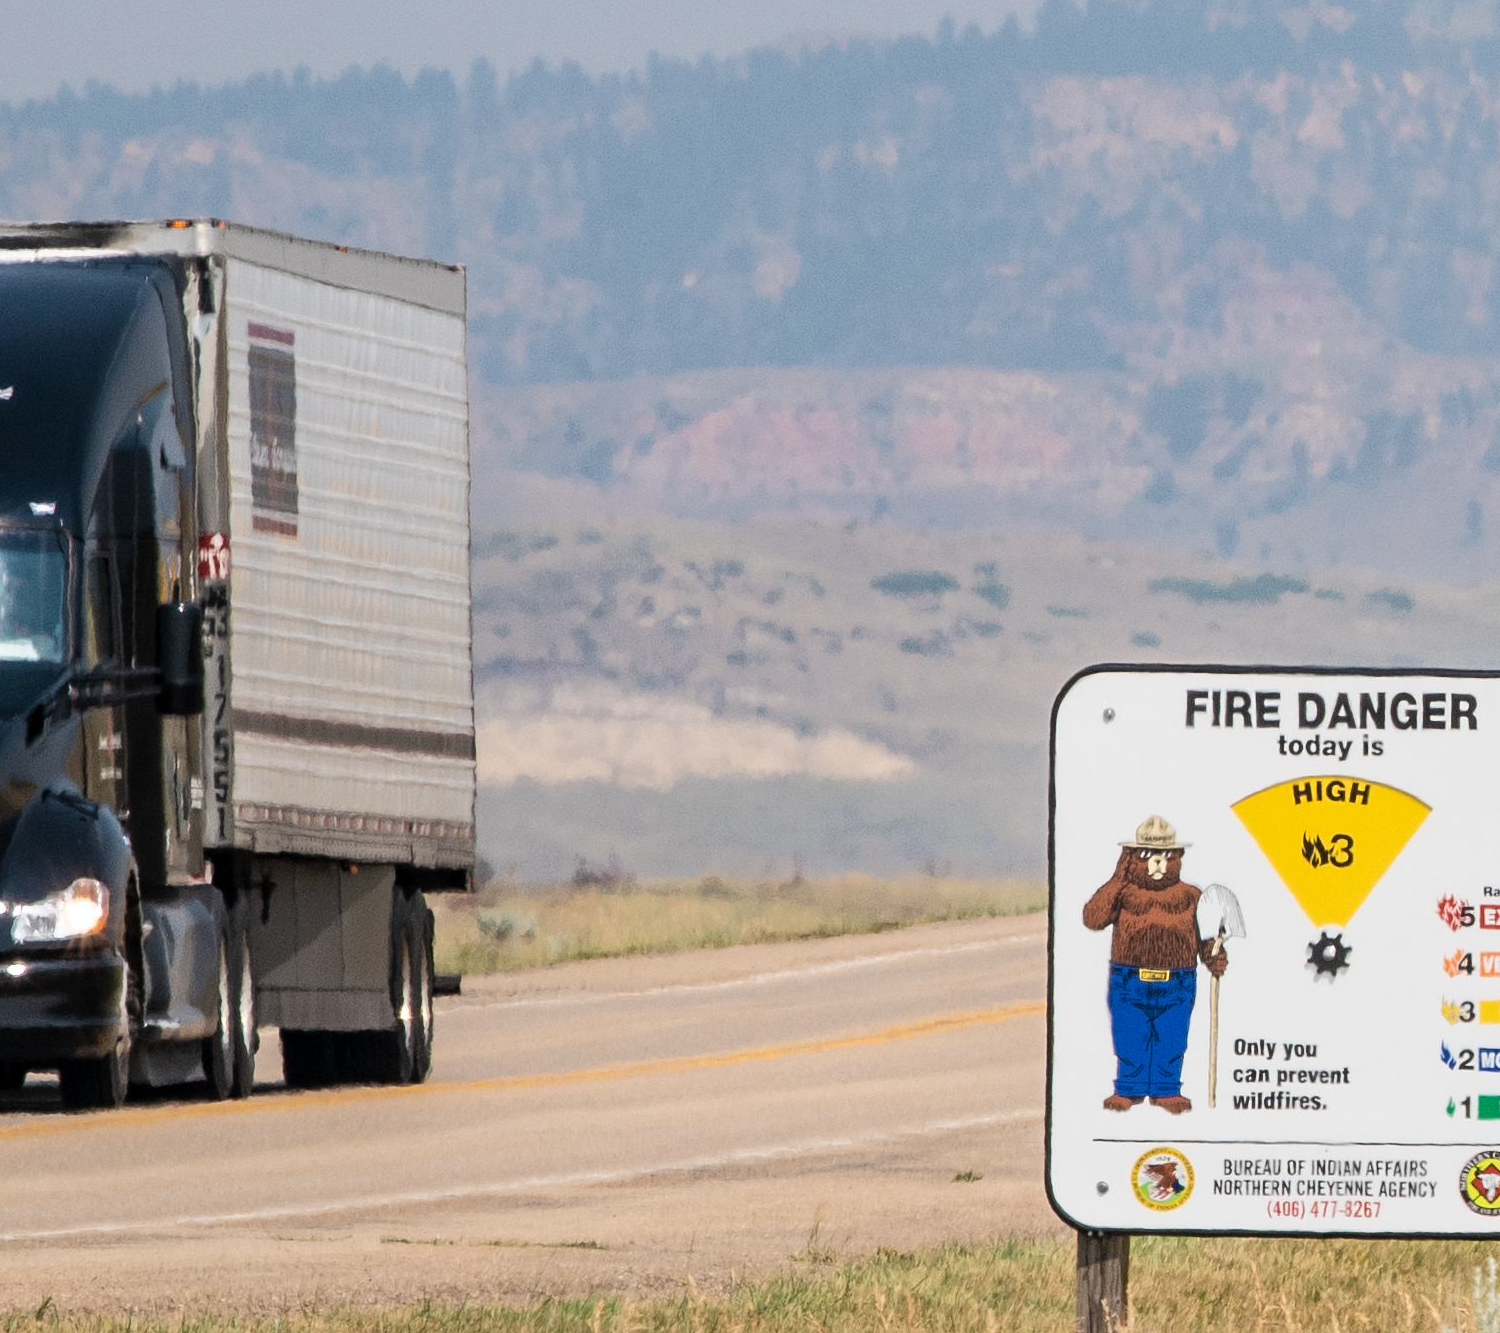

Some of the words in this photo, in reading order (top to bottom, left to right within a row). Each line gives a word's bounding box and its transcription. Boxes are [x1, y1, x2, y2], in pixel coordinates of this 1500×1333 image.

[1185, 690, 1281, 729] FIRE
[1298, 692, 1478, 731] DANGER
[1277, 733, 1353, 762] today
[1362, 733, 1384, 757] is
[1292, 780, 1371, 806] HIGH
[1330, 834, 1355, 868] 3
[1460, 906, 1475, 927] 5
[1458, 953, 1475, 975] 4
[1459, 1001, 1475, 1023] 3
[1233, 1038, 1276, 1061] Only
[1283, 1043, 1317, 1061] you
[1458, 1049, 1475, 1071] 2
[1233, 1068, 1270, 1083] can
[1277, 1067, 1350, 1087] prevent
[1233, 1090, 1327, 1111] wildfires.
[1460, 1096, 1471, 1118] 1
[1223, 1158, 1282, 1176] BUREAU
[1286, 1159, 1304, 1176] OF
[1312, 1159, 1362, 1176] INDIAN
[1366, 1160, 1427, 1177] AFFAIRS
[1213, 1179, 1292, 1196] NORTHERN
[1296, 1179, 1372, 1197] CHEYENNE
[1378, 1180, 1435, 1198] AGENCY
[1267, 1200, 1306, 1219] (406)
[1310, 1199, 1381, 1219] 477-8267
